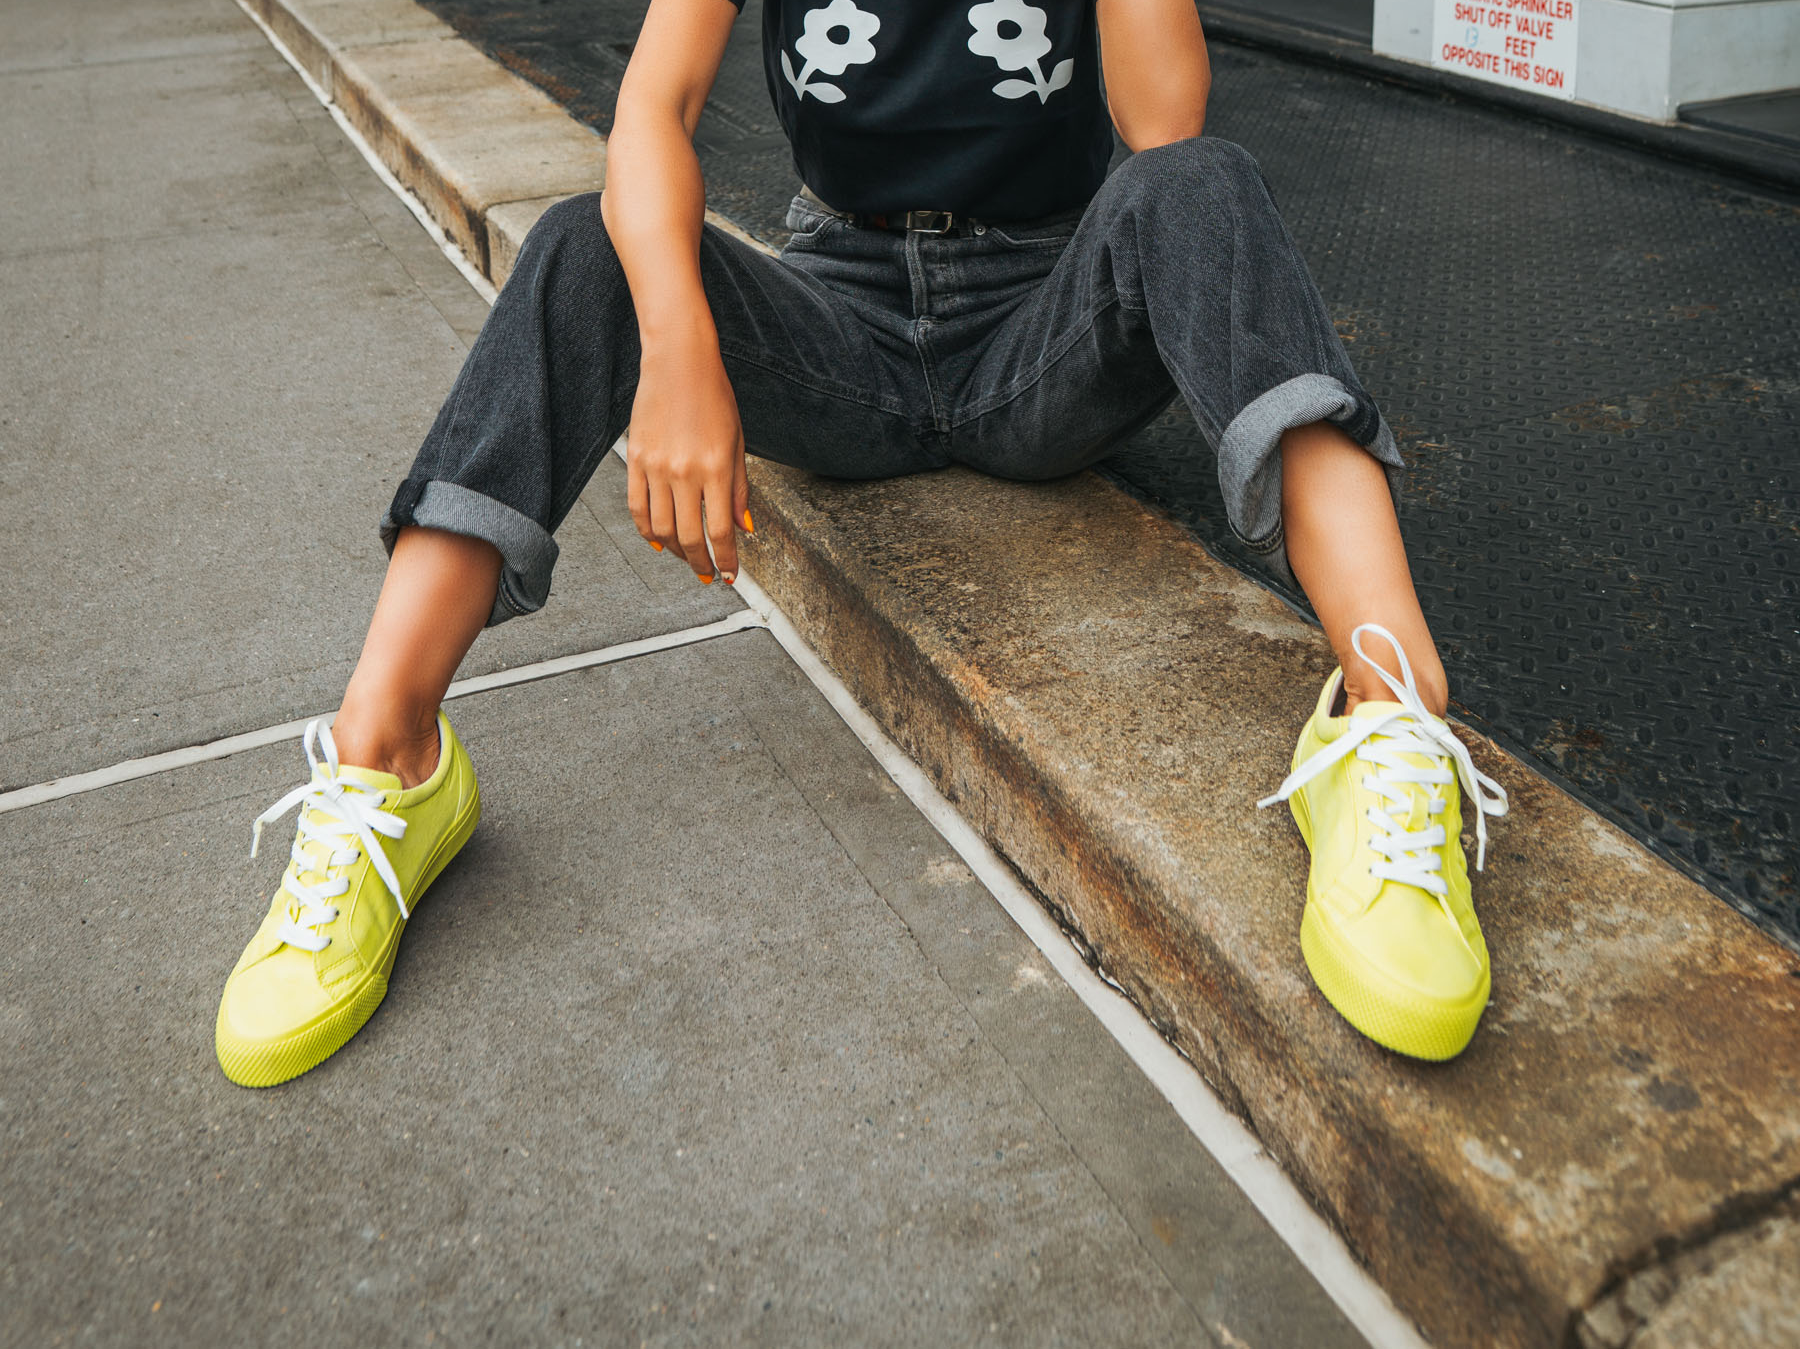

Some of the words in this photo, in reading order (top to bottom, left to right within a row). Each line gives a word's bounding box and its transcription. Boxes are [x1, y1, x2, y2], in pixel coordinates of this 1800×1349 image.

[1455, 3, 1485, 25] SHUT
[1488, 10, 1512, 30] OFF
[1515, 15, 1554, 40] VALVE
[1442, 43, 1500, 74] OPPOSITE
[1504, 58, 1530, 81] THIS
[1533, 65, 1564, 88] SIGN
[1505, 36, 1536, 59] FEET
